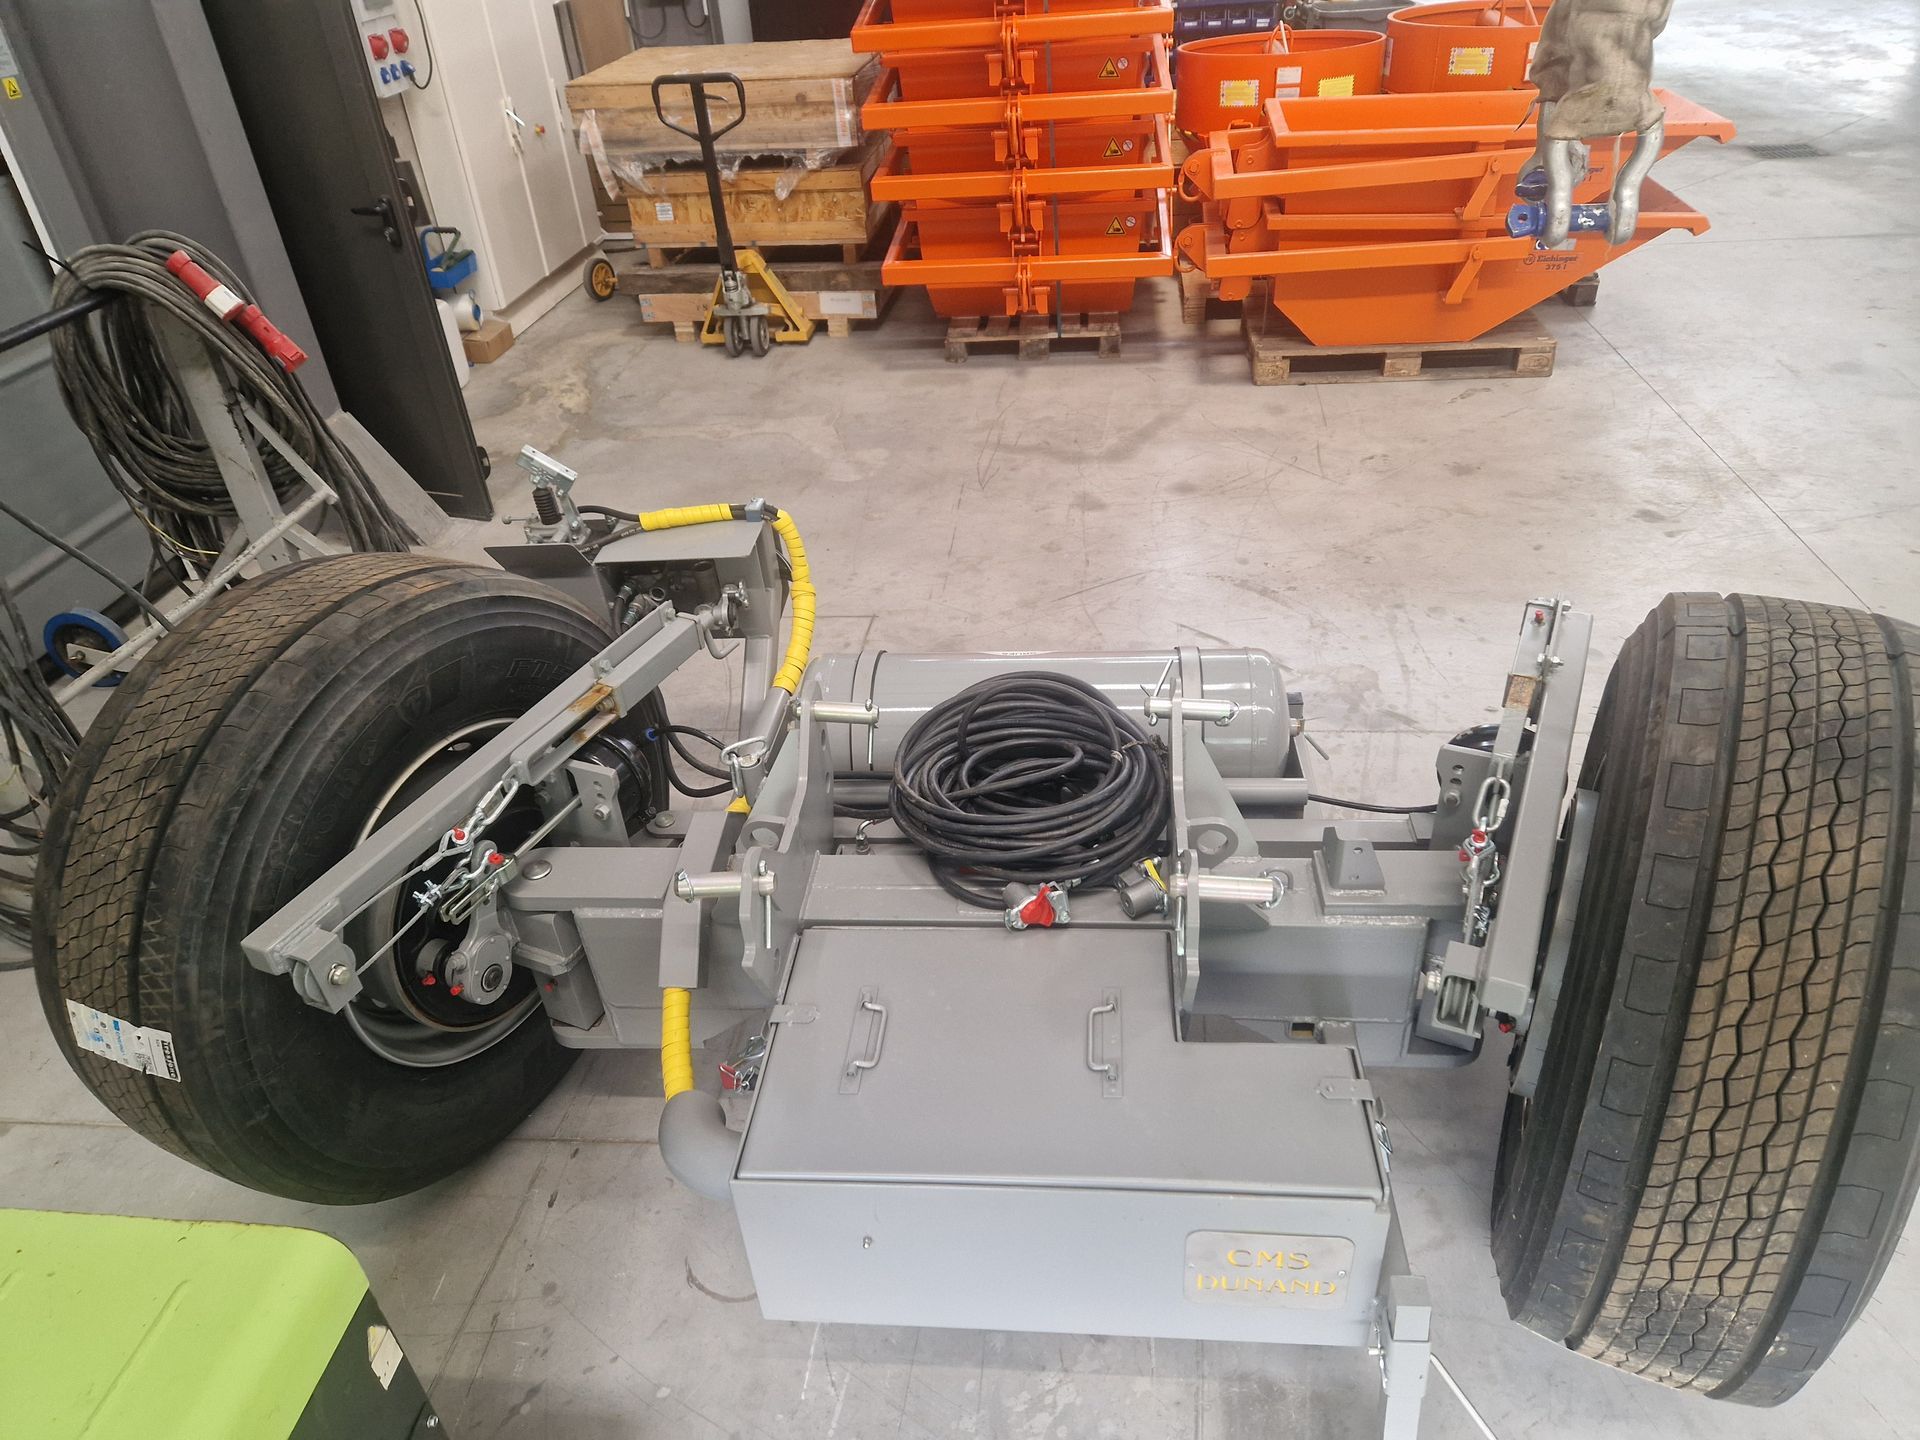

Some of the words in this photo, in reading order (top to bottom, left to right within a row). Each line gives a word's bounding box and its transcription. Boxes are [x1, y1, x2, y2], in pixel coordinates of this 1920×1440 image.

[1536, 254, 1578, 264] Eichinger
[1226, 1249, 1312, 1271] CMS
[1195, 1273, 1337, 1297] DUNAND
